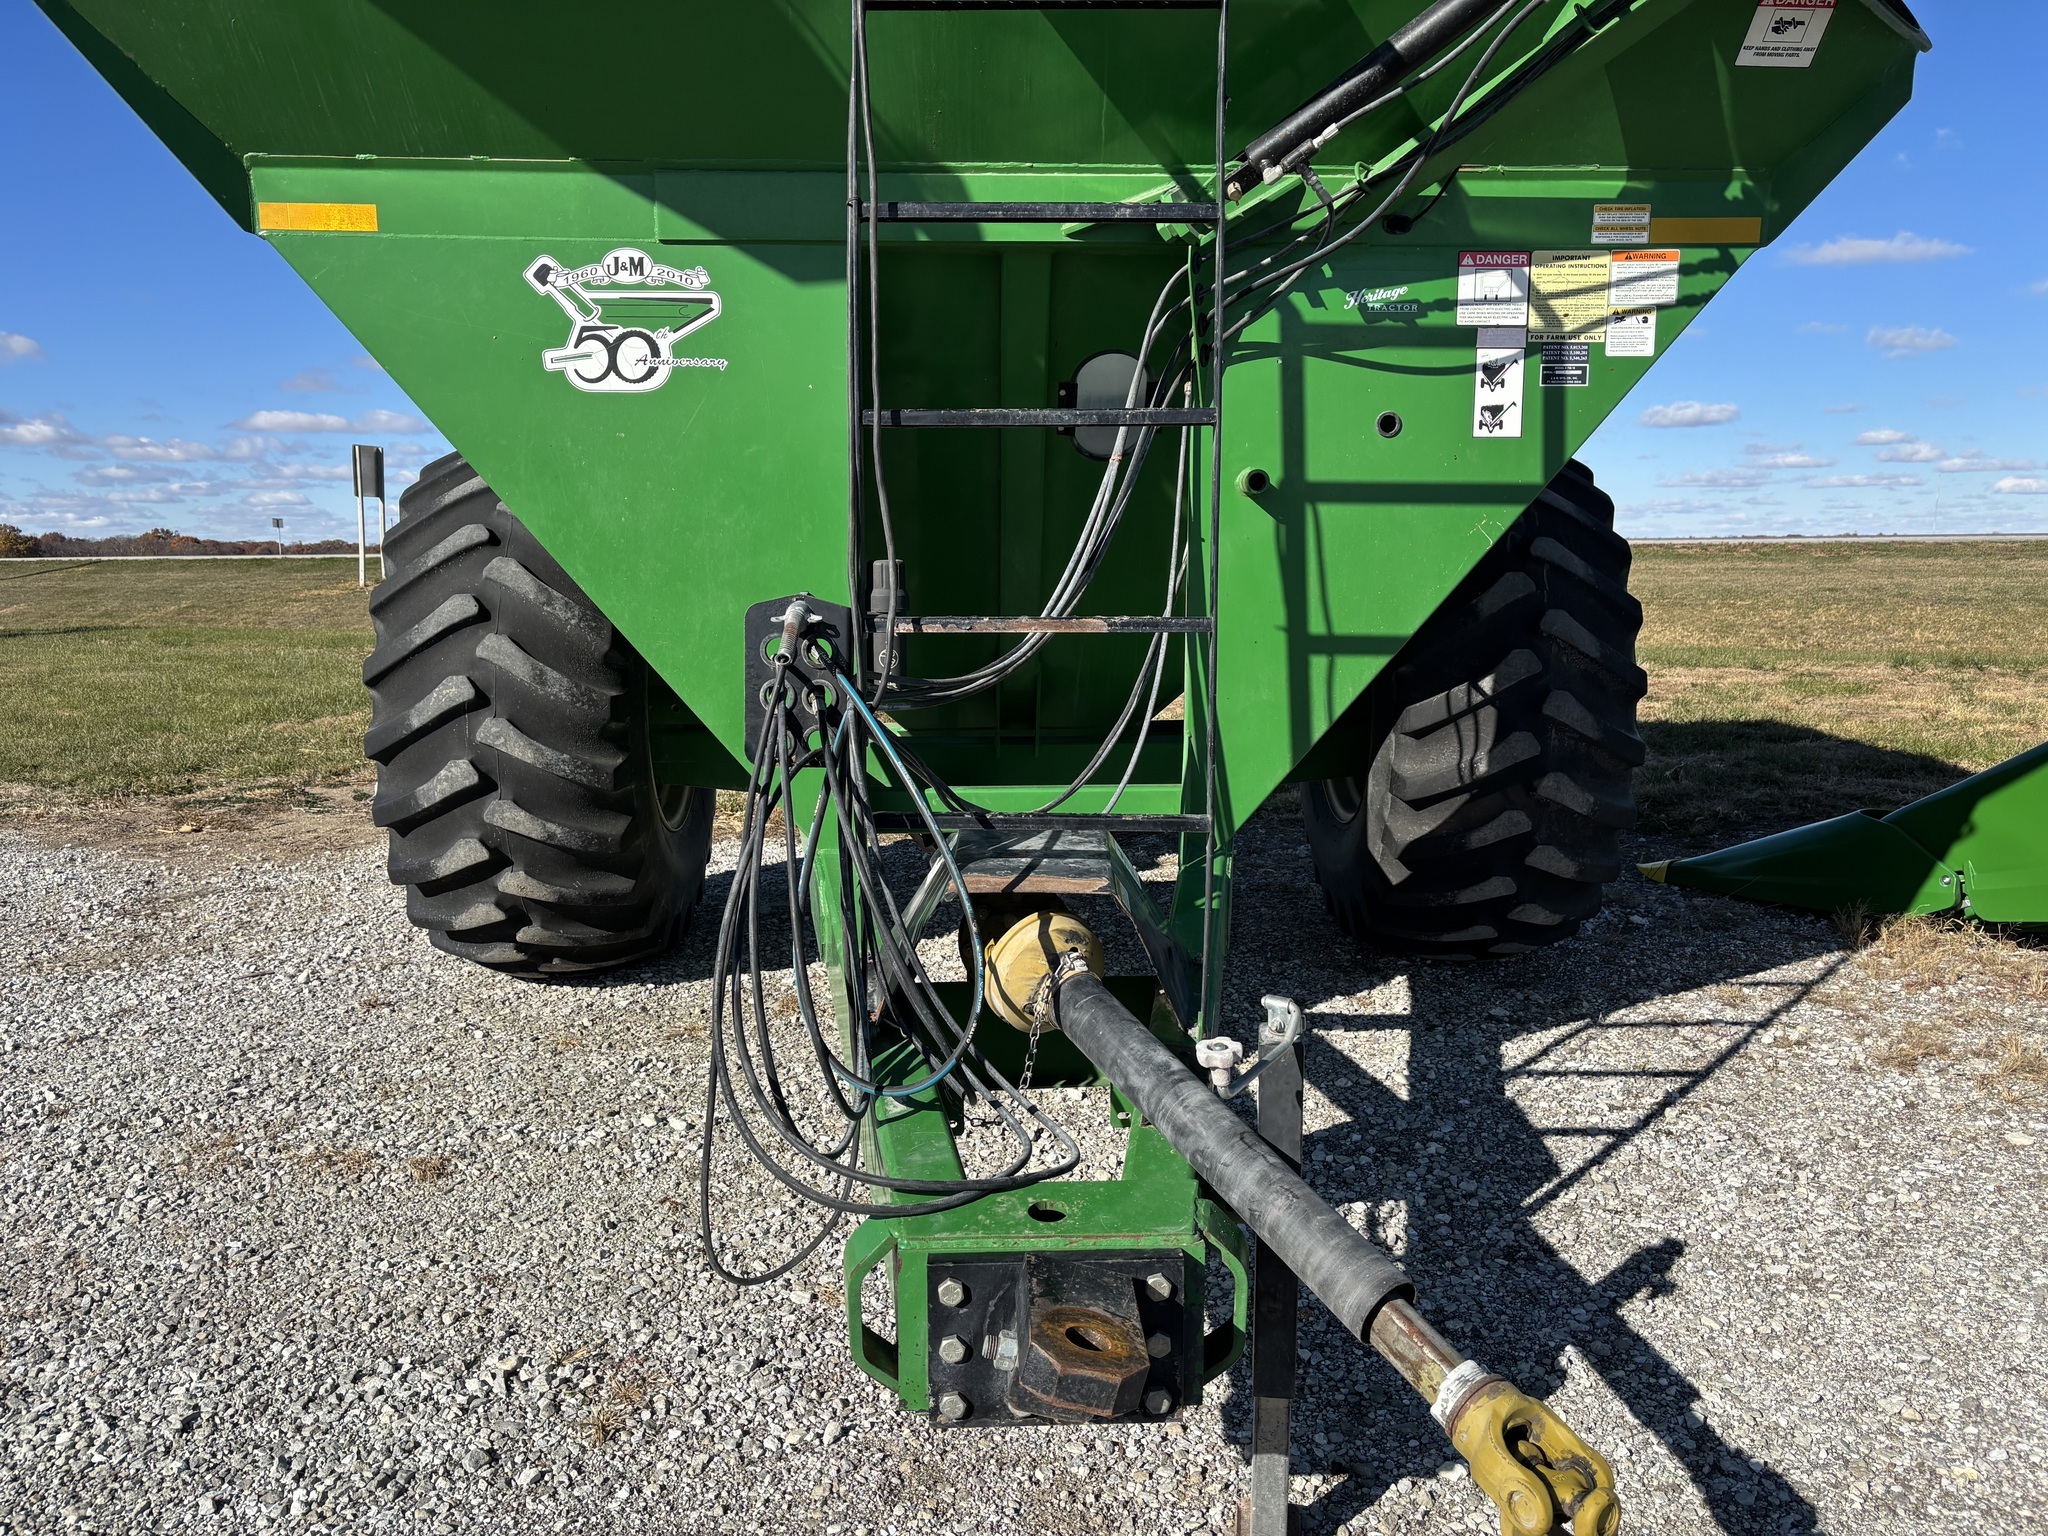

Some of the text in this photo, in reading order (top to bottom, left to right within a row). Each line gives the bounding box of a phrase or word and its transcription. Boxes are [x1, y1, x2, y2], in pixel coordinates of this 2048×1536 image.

[1476, 254, 1528, 265] DANGER
[563, 256, 694, 286] 1960 J&M 2010
[1343, 286, 1409, 310] Heritage
[634, 354, 727, 370] Anniversary
